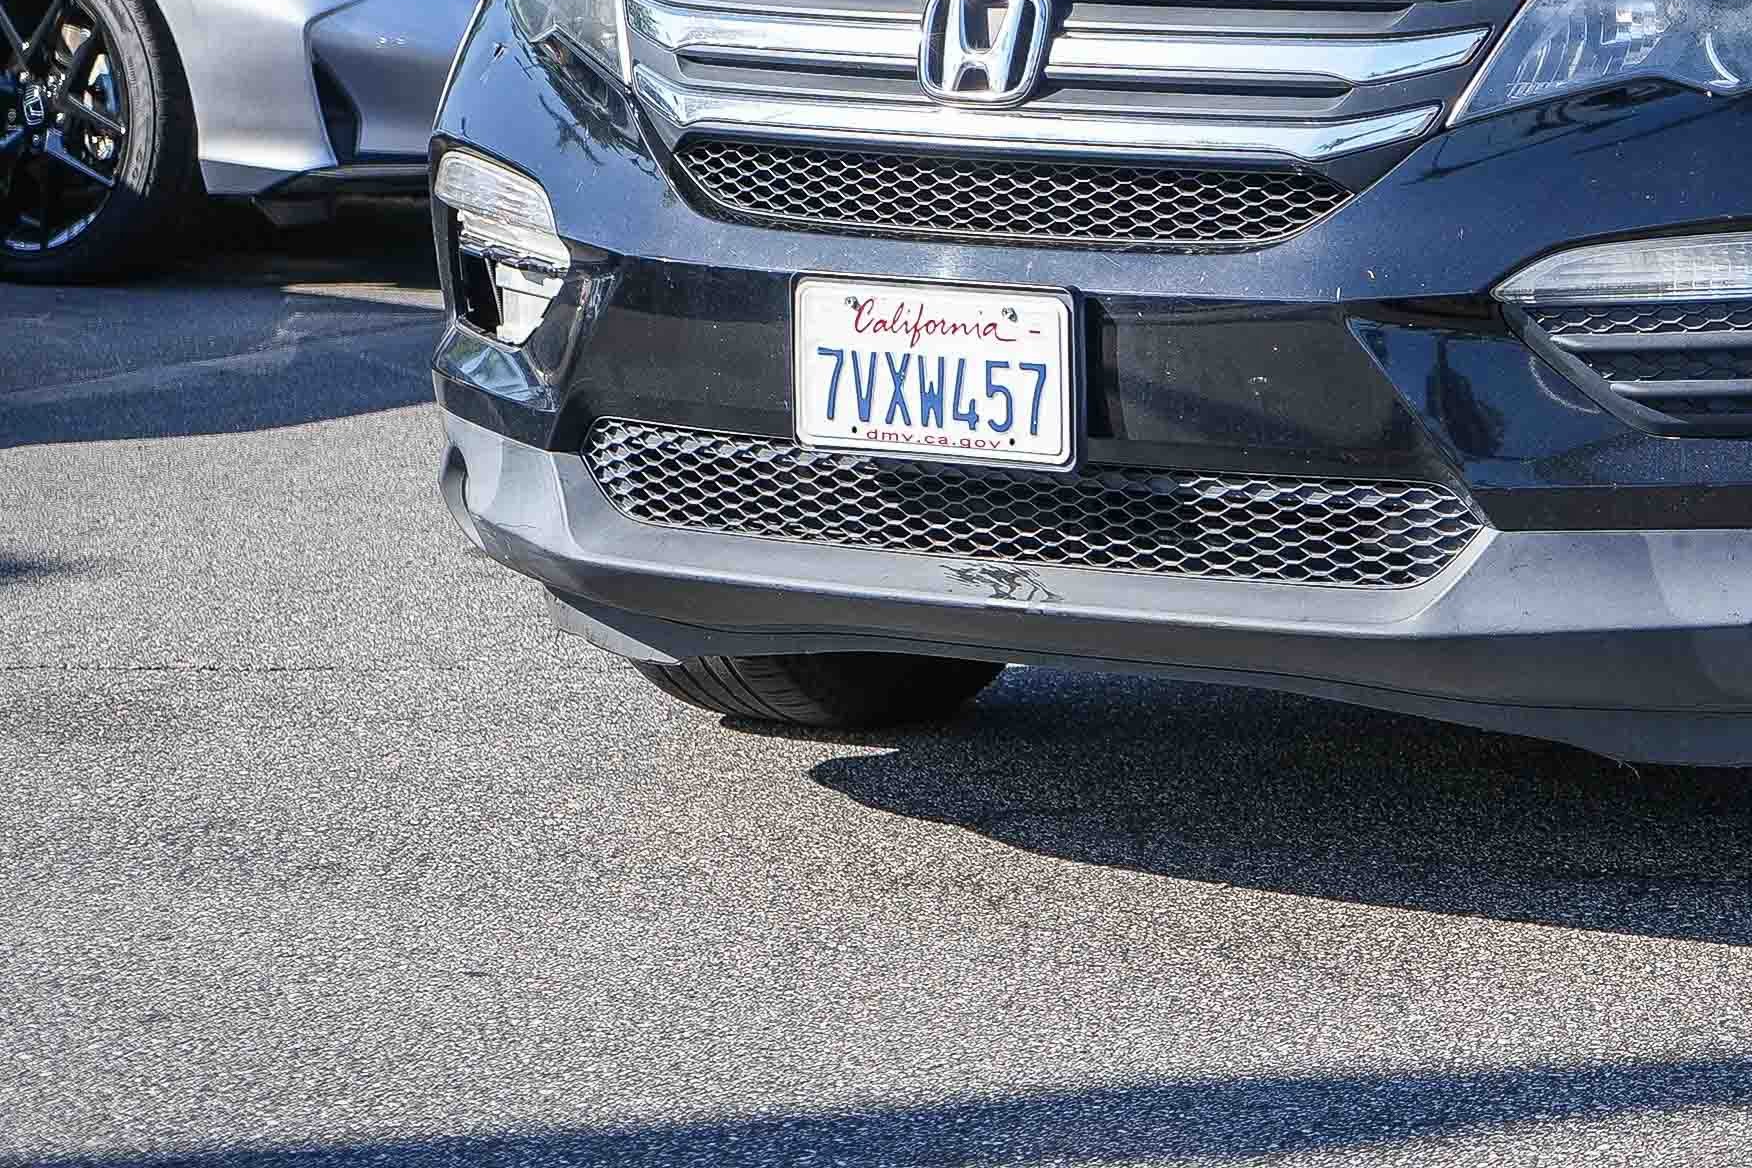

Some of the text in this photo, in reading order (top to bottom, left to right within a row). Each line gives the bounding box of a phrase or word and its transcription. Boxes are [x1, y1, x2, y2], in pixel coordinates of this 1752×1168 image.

[853, 297, 1017, 348] California
[816, 346, 1048, 436] 7VXW457
[865, 428, 1001, 450] dmv.ca.gov
